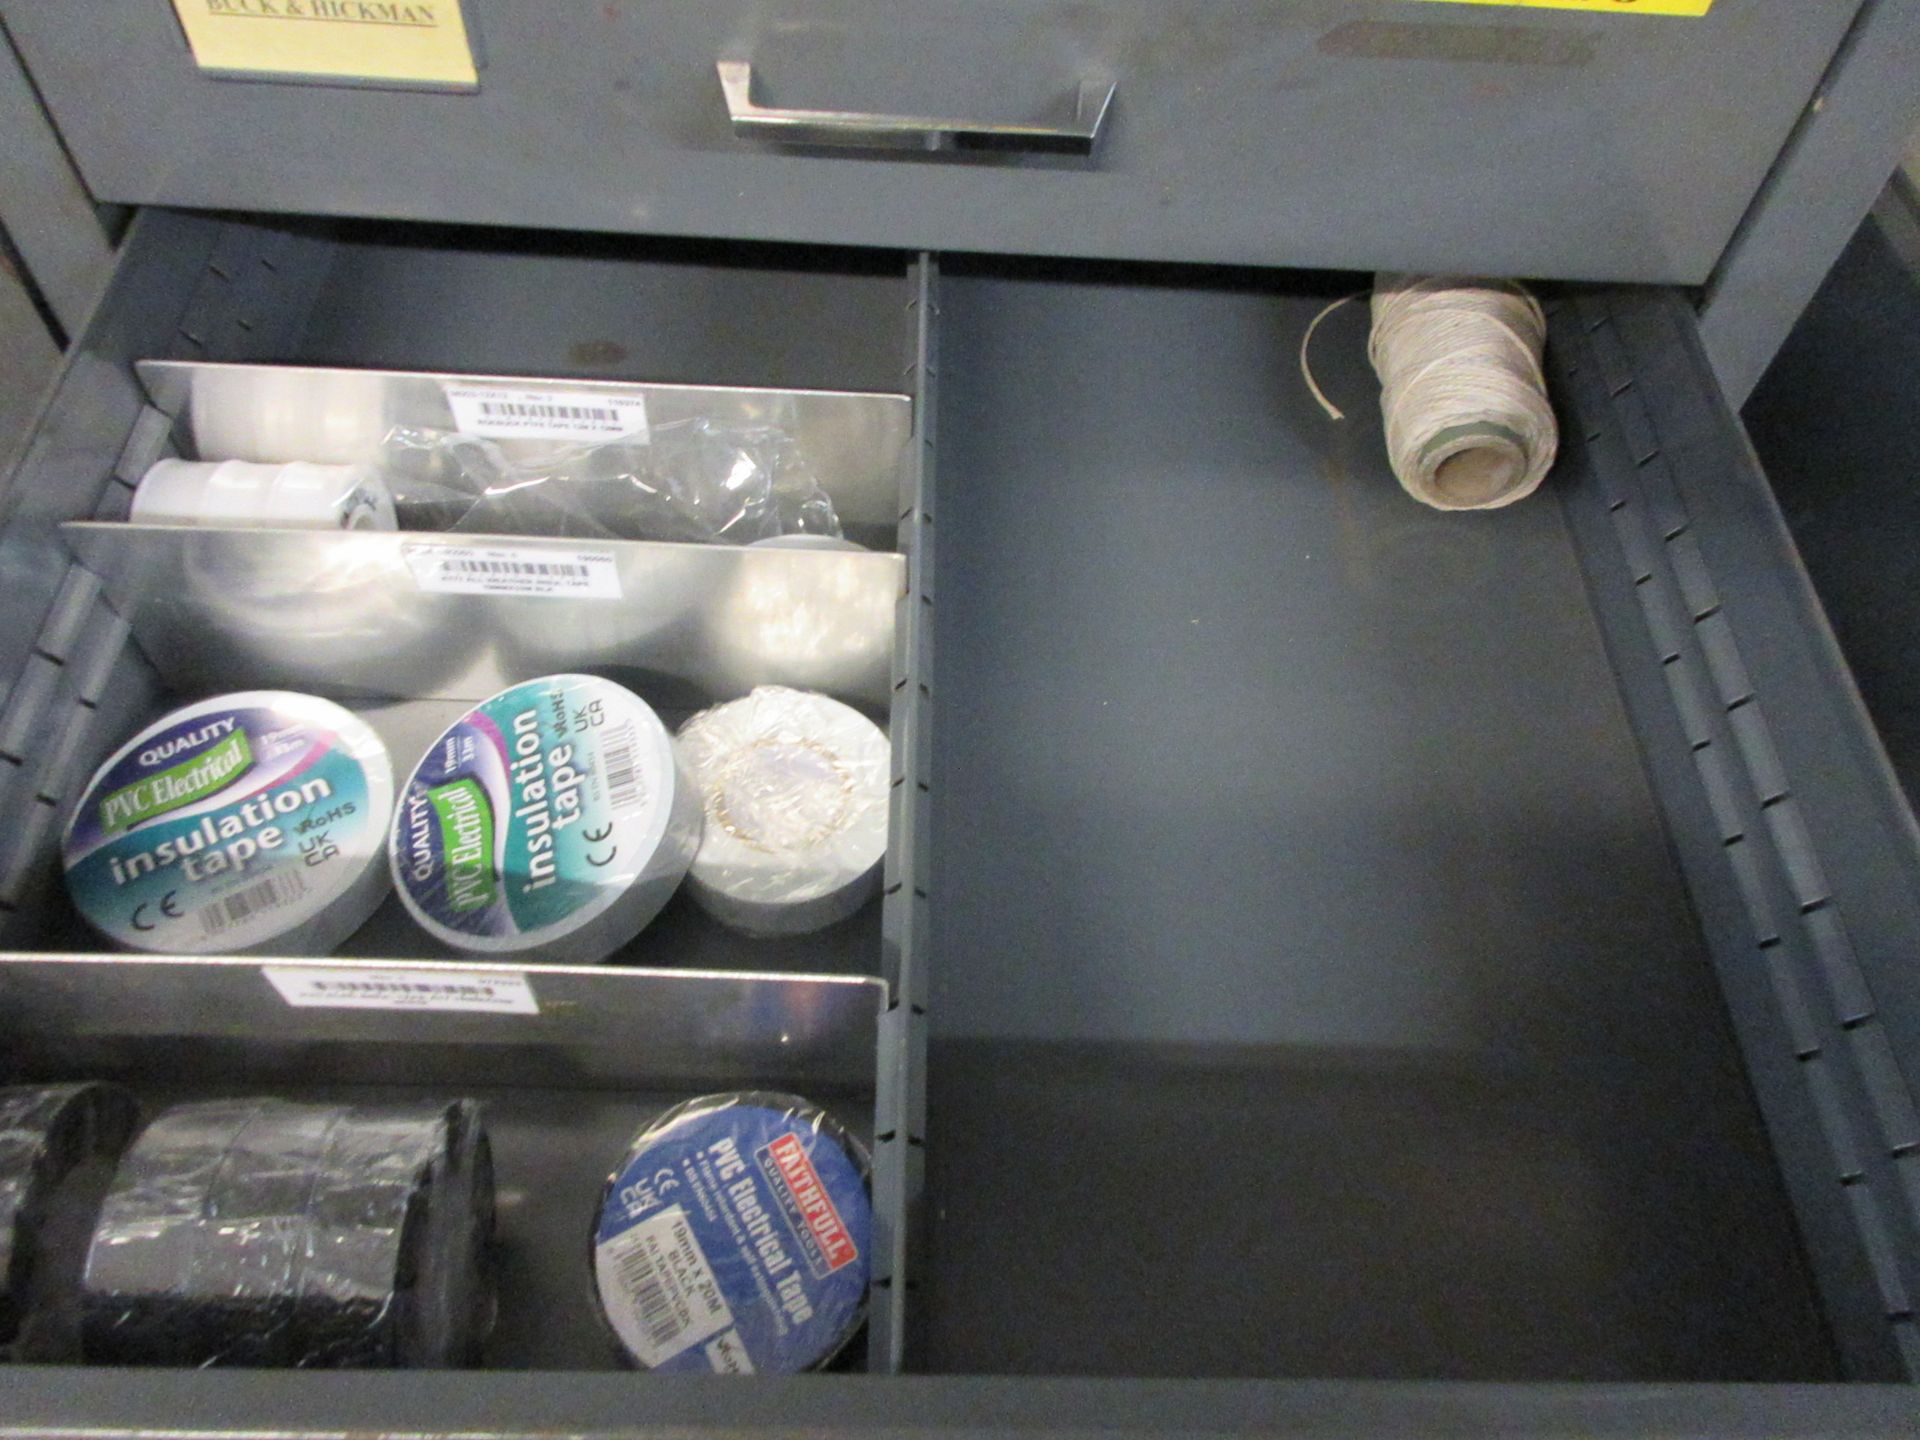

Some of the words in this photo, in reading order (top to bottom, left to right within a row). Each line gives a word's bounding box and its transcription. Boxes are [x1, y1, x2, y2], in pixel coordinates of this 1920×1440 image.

[311, 0, 435, 22] HICKMAN
[138, 715, 238, 767] QUALITY
[574, 704, 589, 732] UK
[586, 700, 605, 726] CA
[101, 788, 150, 827] PVC
[150, 738, 244, 804] Electrical
[511, 709, 556, 893] insulation
[548, 742, 584, 830] tape
[109, 775, 333, 885] insulation
[299, 830, 331, 855] UK
[409, 796, 435, 882] QUALITY
[437, 785, 483, 861] Electrical
[182, 826, 285, 882] tape
[304, 843, 340, 867] CA
[451, 862, 489, 906] PVC
[763, 1157, 796, 1214] QUALITY
[775, 1140, 848, 1261] FAITHFULL
[707, 1136, 746, 1180] PVC
[728, 1176, 793, 1276] Electrical
[776, 1270, 814, 1326] Tape
[666, 1250, 695, 1298] BLACK
[670, 1220, 698, 1268] 19mm
[698, 1281, 722, 1316] 20M
